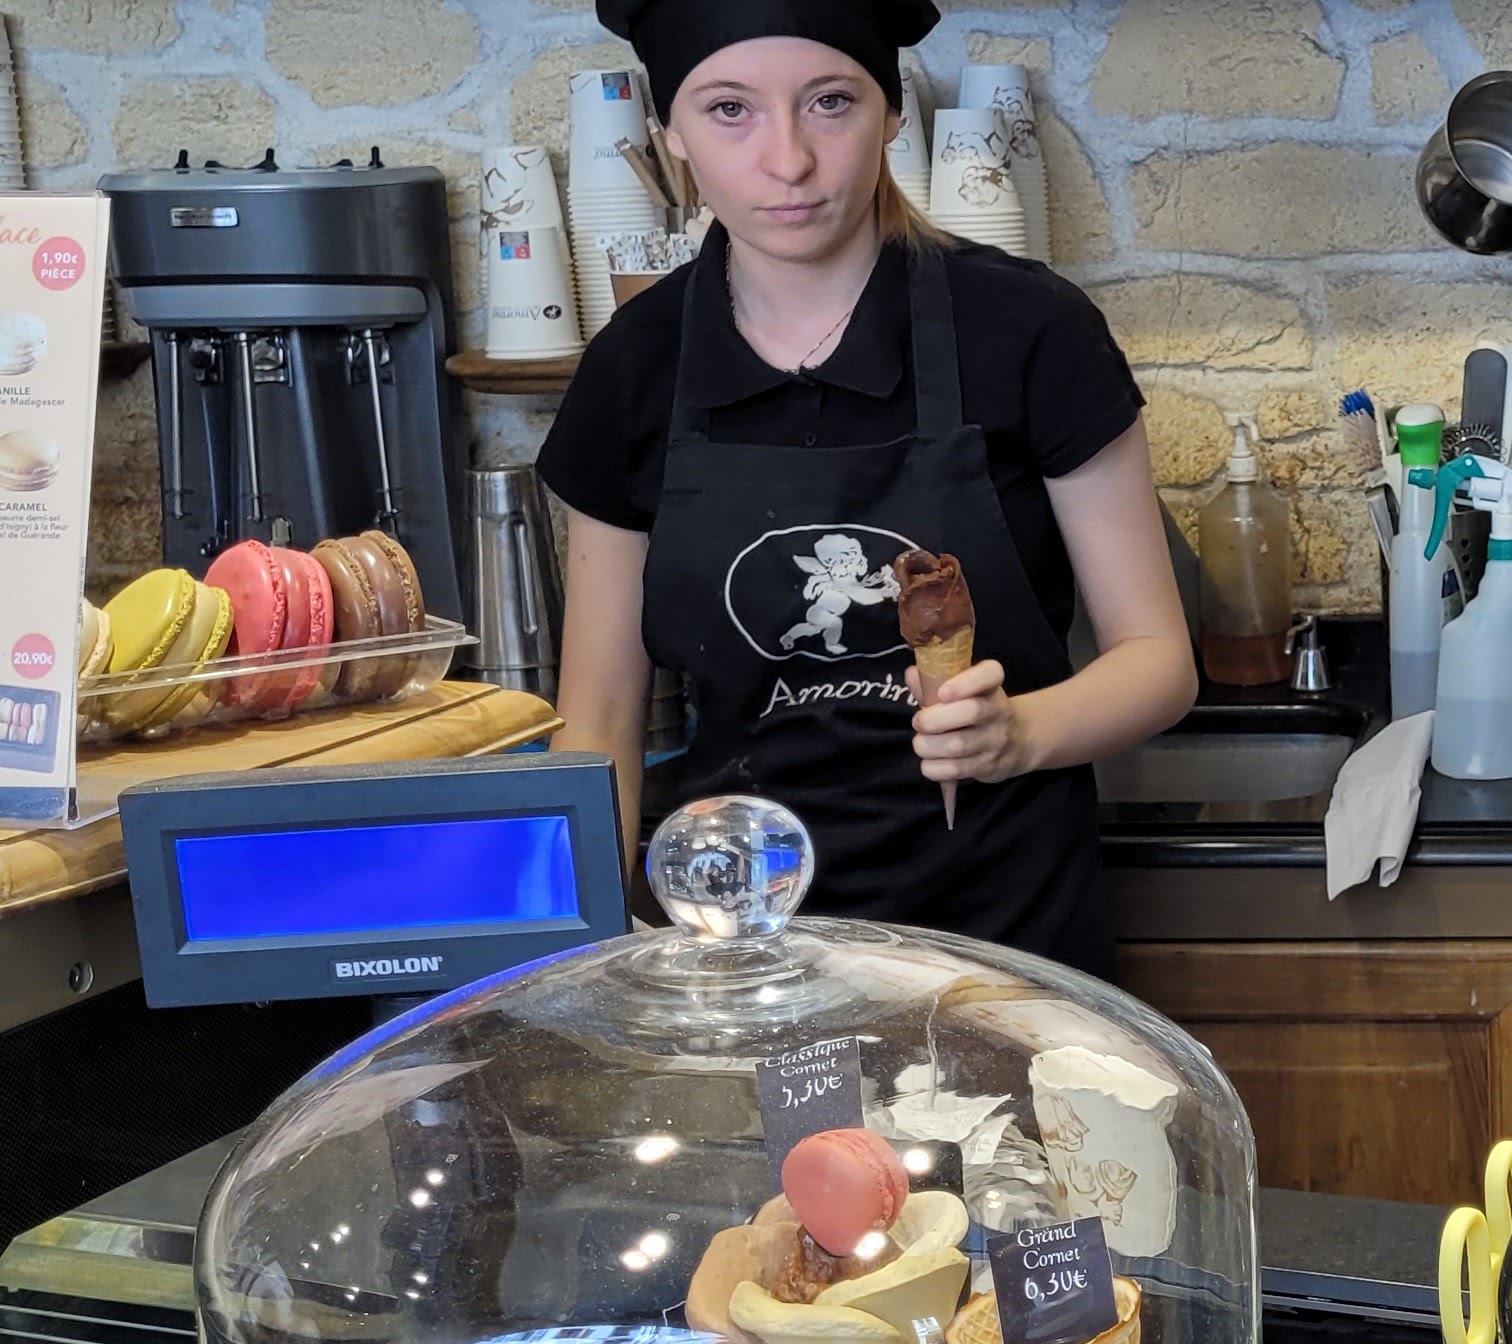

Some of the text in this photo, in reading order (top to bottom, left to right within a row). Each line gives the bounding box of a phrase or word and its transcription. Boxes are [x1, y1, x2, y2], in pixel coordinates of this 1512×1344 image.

[41, 267, 76, 278] PIÈCE
[760, 674, 920, 718] Amorin
[335, 956, 444, 979] BIXOLON
[765, 1040, 849, 1068] Classique
[780, 1058, 837, 1077] Cornet
[1018, 1220, 1076, 1247] Grand
[1024, 1248, 1080, 1269] Cornet
